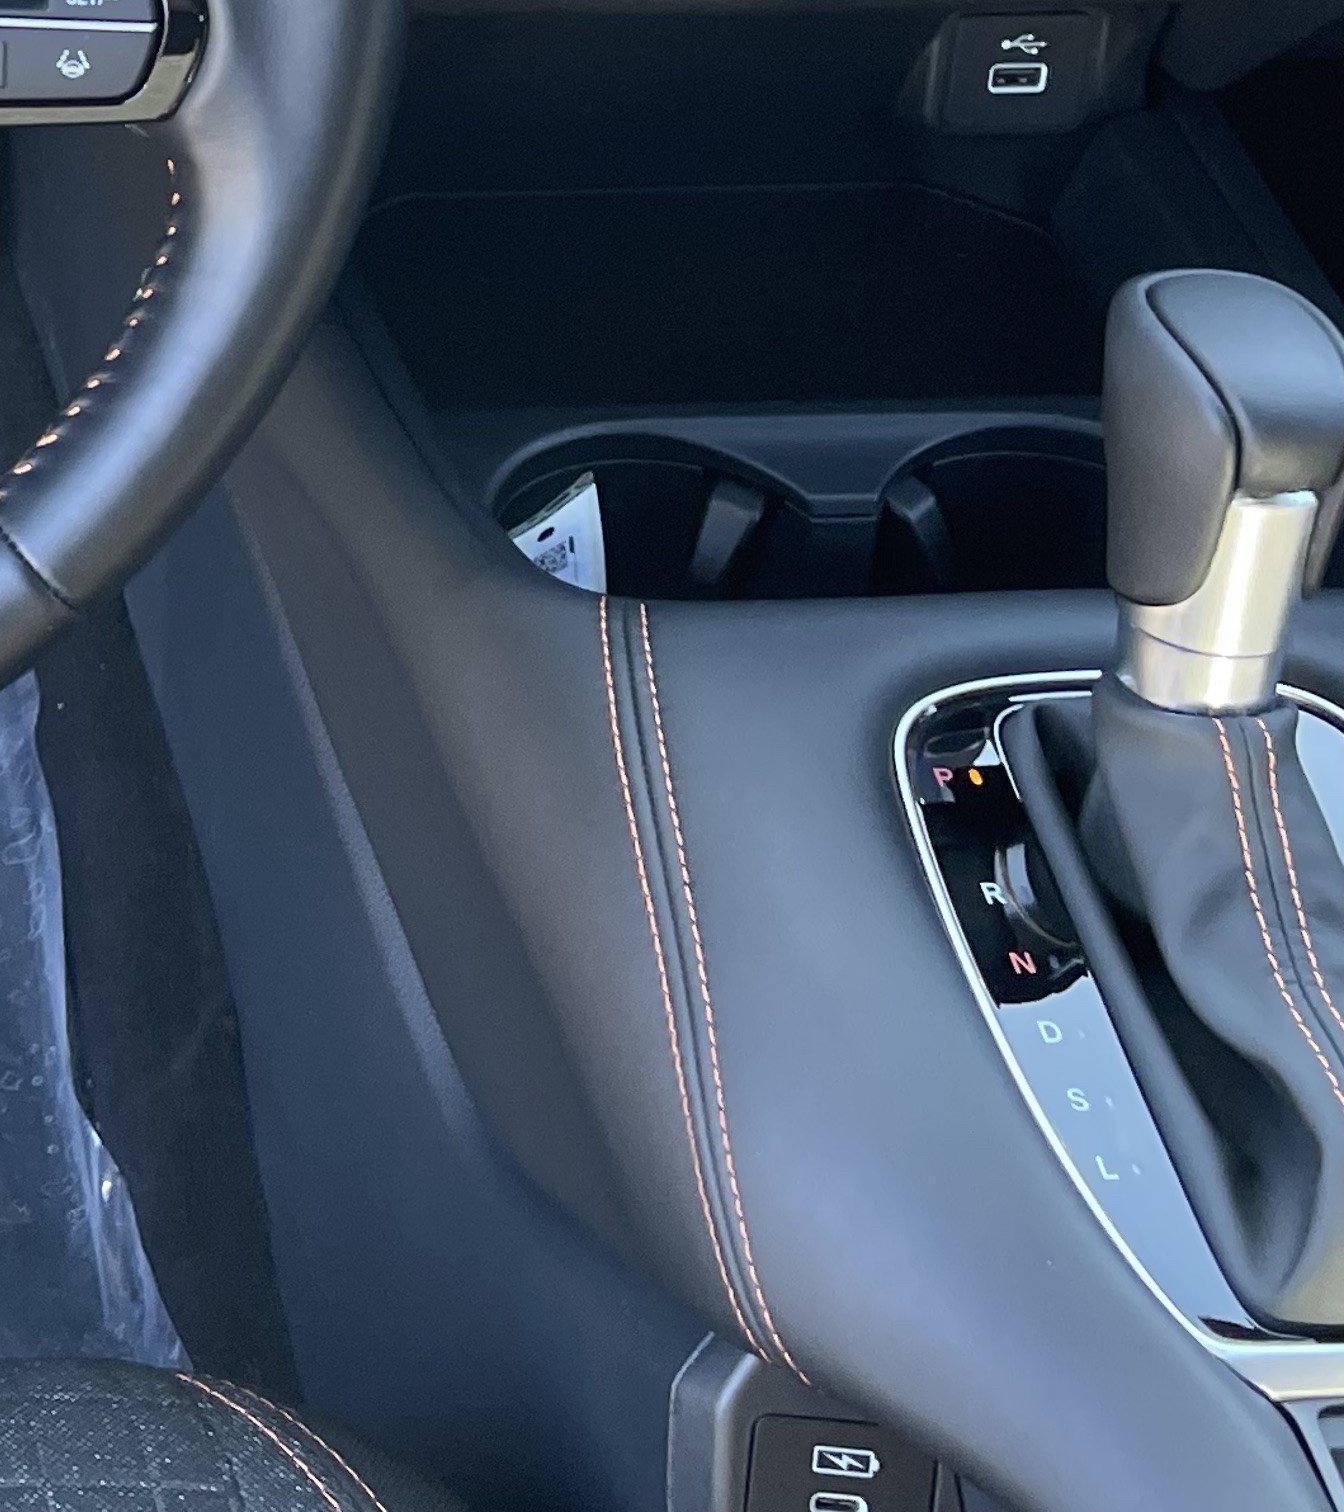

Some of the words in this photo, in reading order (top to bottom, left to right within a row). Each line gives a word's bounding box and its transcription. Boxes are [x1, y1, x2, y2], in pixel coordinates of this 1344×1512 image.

[932, 767, 954, 789] P
[980, 881, 1006, 905] R
[1008, 951, 1037, 975] N
[1037, 1020, 1062, 1044] D
[1067, 1088, 1090, 1112] S
[1096, 1155, 1120, 1181] L
